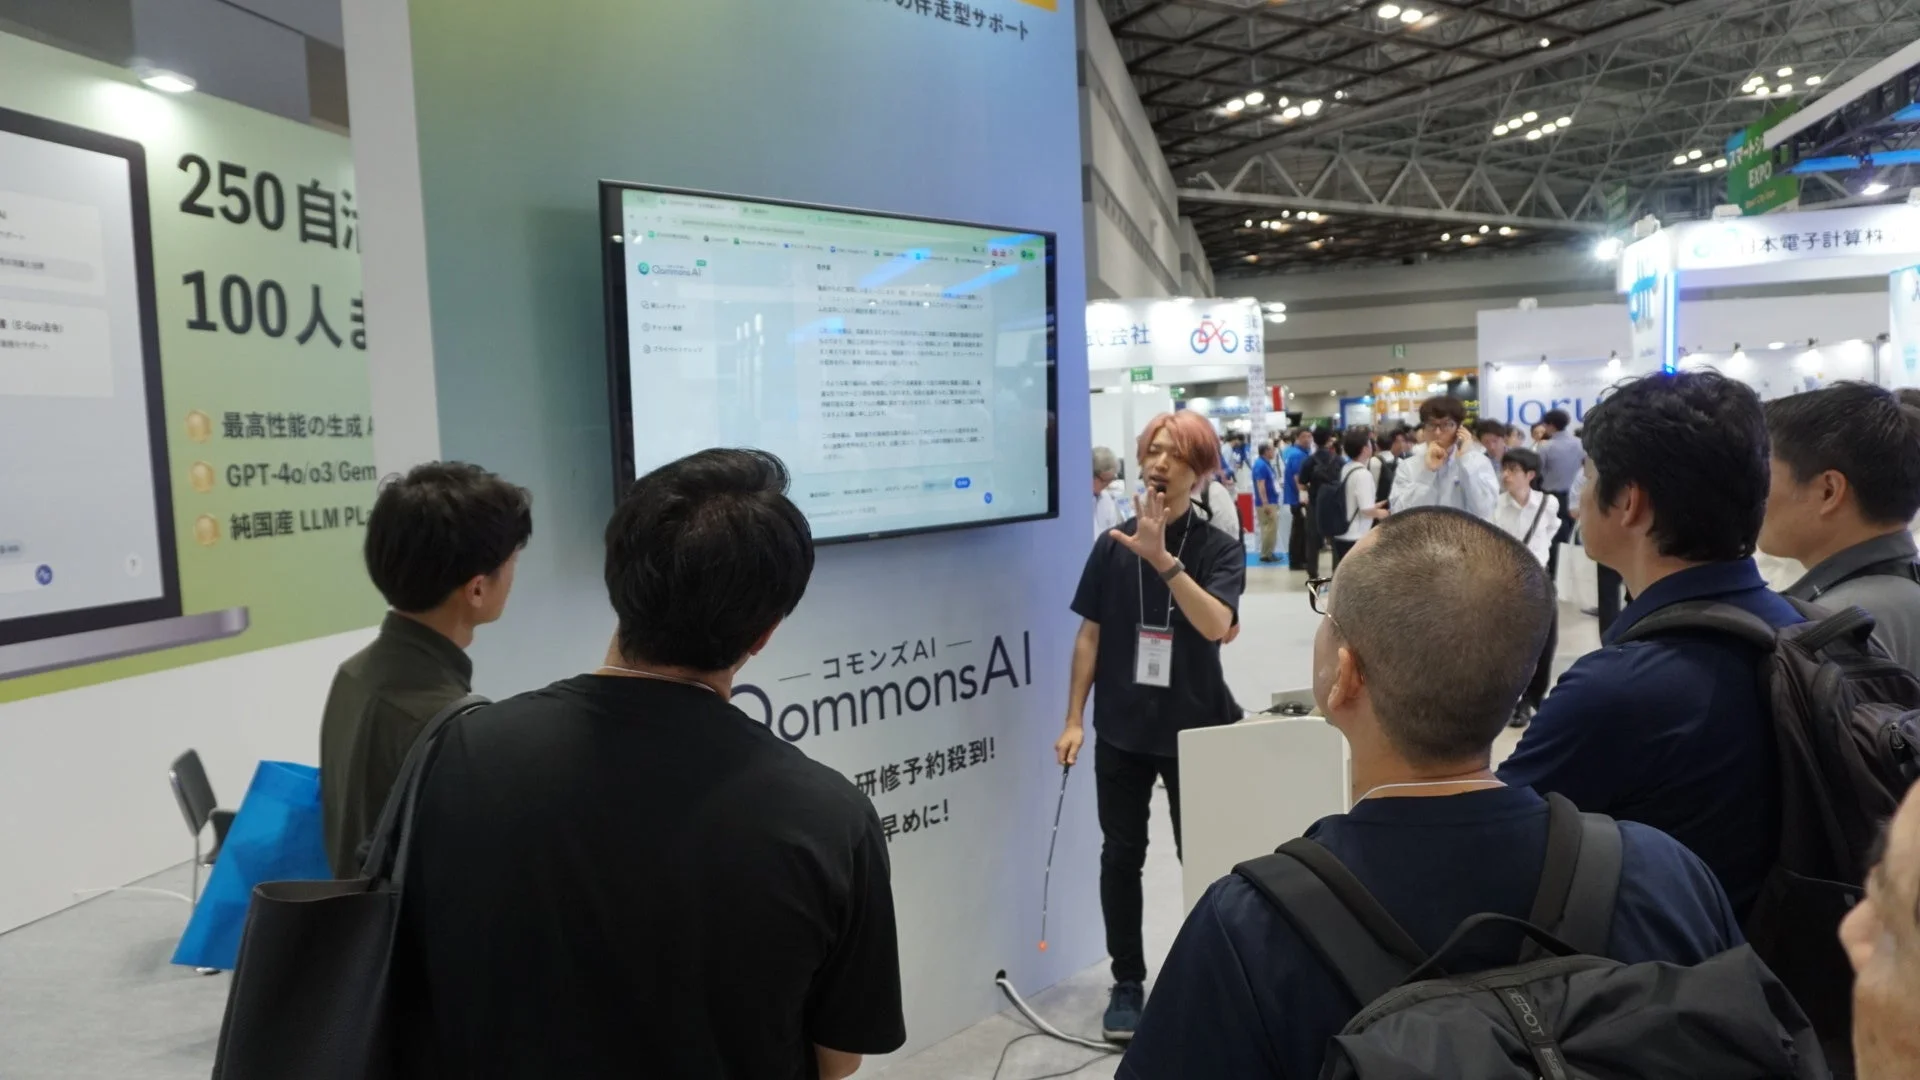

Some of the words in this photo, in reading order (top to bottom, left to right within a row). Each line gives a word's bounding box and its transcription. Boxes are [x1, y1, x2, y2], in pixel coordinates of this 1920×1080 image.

[1747, 160, 1773, 190] EXPO
[222, 411, 363, 440] 最高性能の生成
[229, 509, 294, 541] 純国産
[300, 506, 340, 533] LLM
[823, 637, 936, 680] コモンズAI
